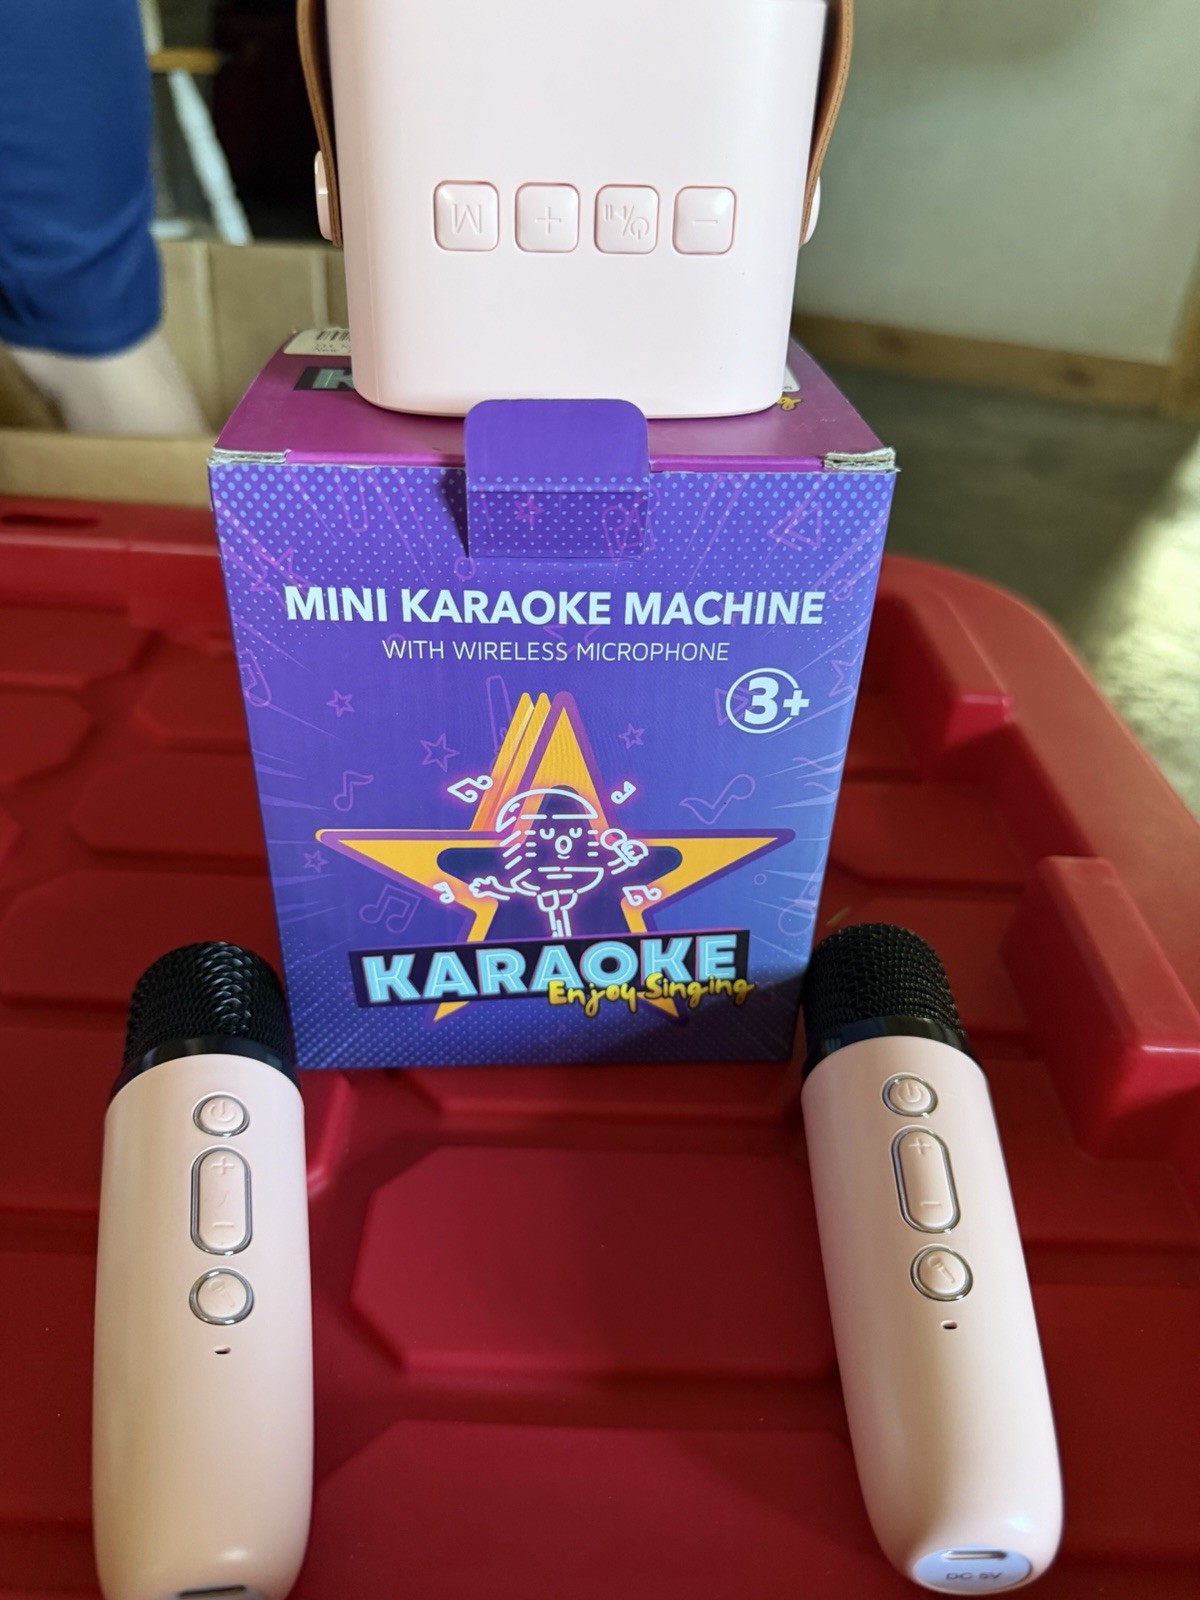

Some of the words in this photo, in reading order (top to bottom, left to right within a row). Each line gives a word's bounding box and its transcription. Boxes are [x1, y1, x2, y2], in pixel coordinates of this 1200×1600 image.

[285, 586, 388, 622] MINI
[401, 588, 611, 625] KARAOKE
[624, 591, 826, 625] MACHINE
[382, 639, 444, 659] WITH
[452, 641, 568, 661] WIRELESS
[576, 642, 730, 661] MICROPHONE
[744, 676, 810, 725] 3+
[362, 934, 738, 1003] KARAOKE
[548, 980, 637, 1016] Enjoy
[645, 973, 755, 1009] Singing
[946, 1572, 973, 1580] DC
